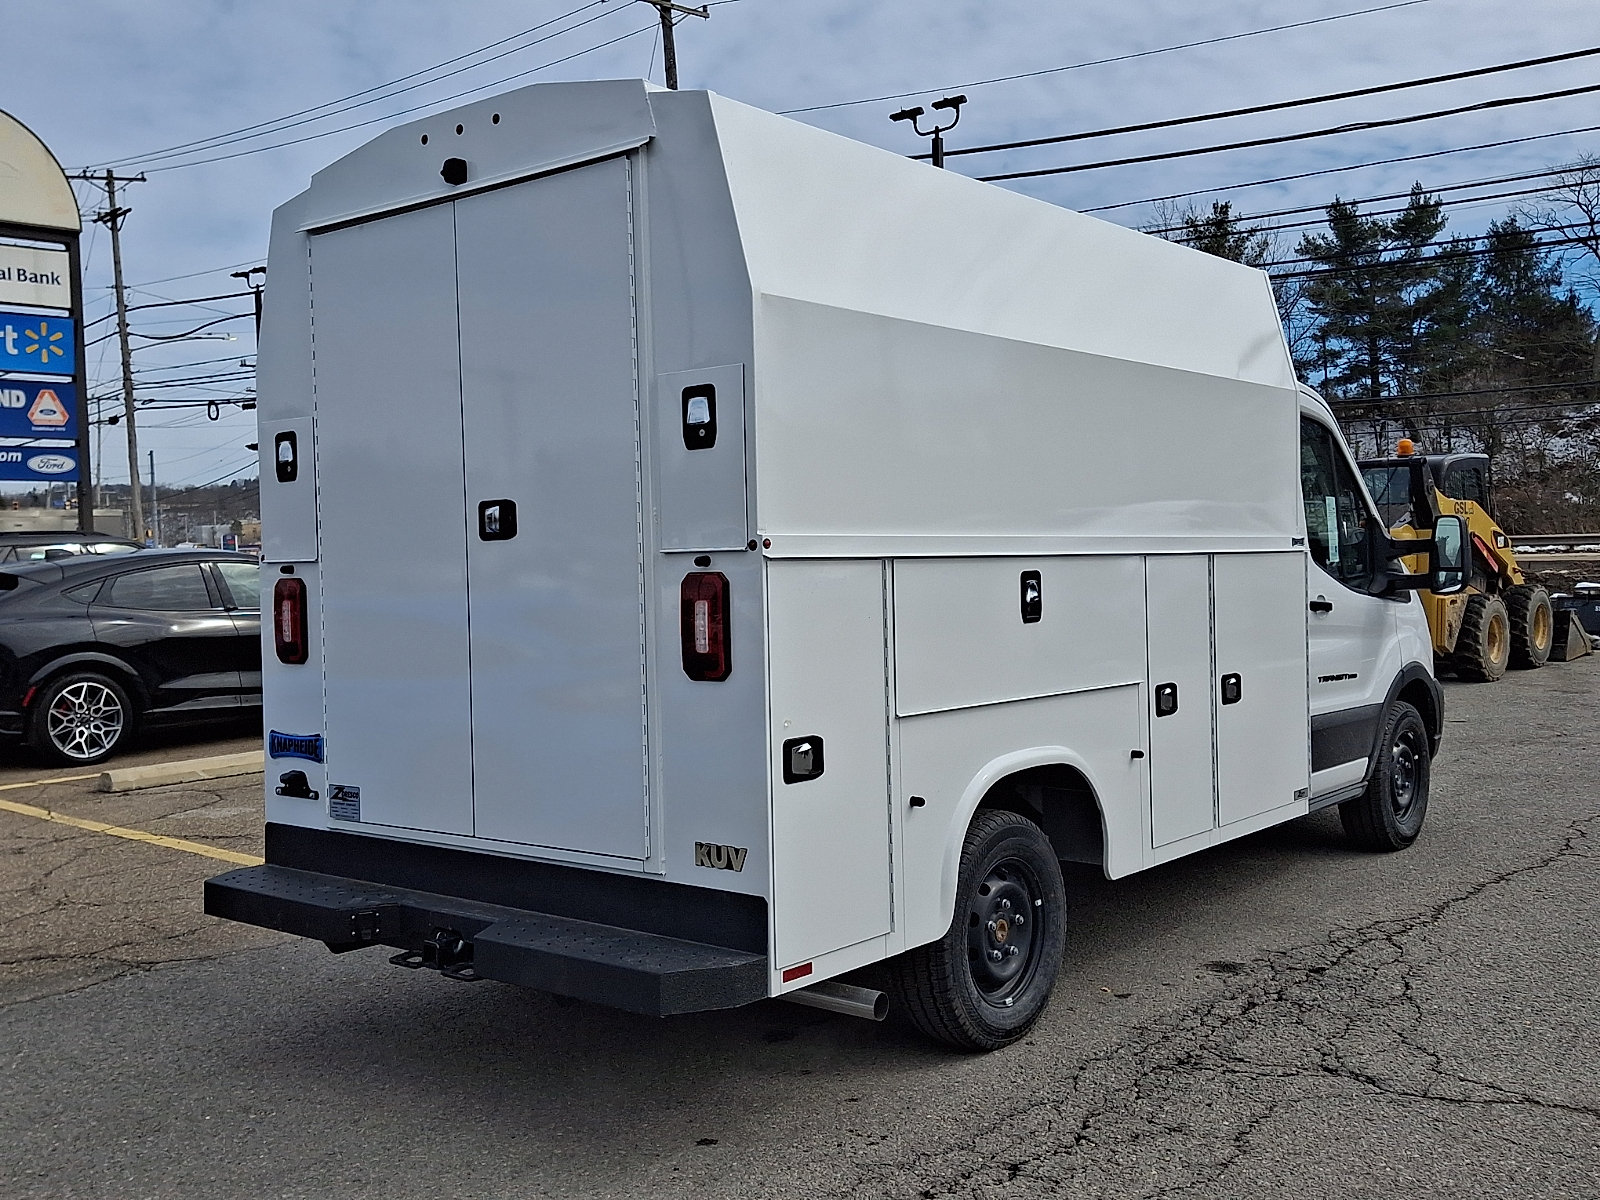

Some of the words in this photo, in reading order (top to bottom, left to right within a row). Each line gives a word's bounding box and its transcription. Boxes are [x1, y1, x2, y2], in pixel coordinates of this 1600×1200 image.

[17, 268, 61, 286] Bank
[37, 458, 65, 469] Ford
[272, 734, 320, 759] KNAPHEIDE
[694, 841, 747, 872] KUV
